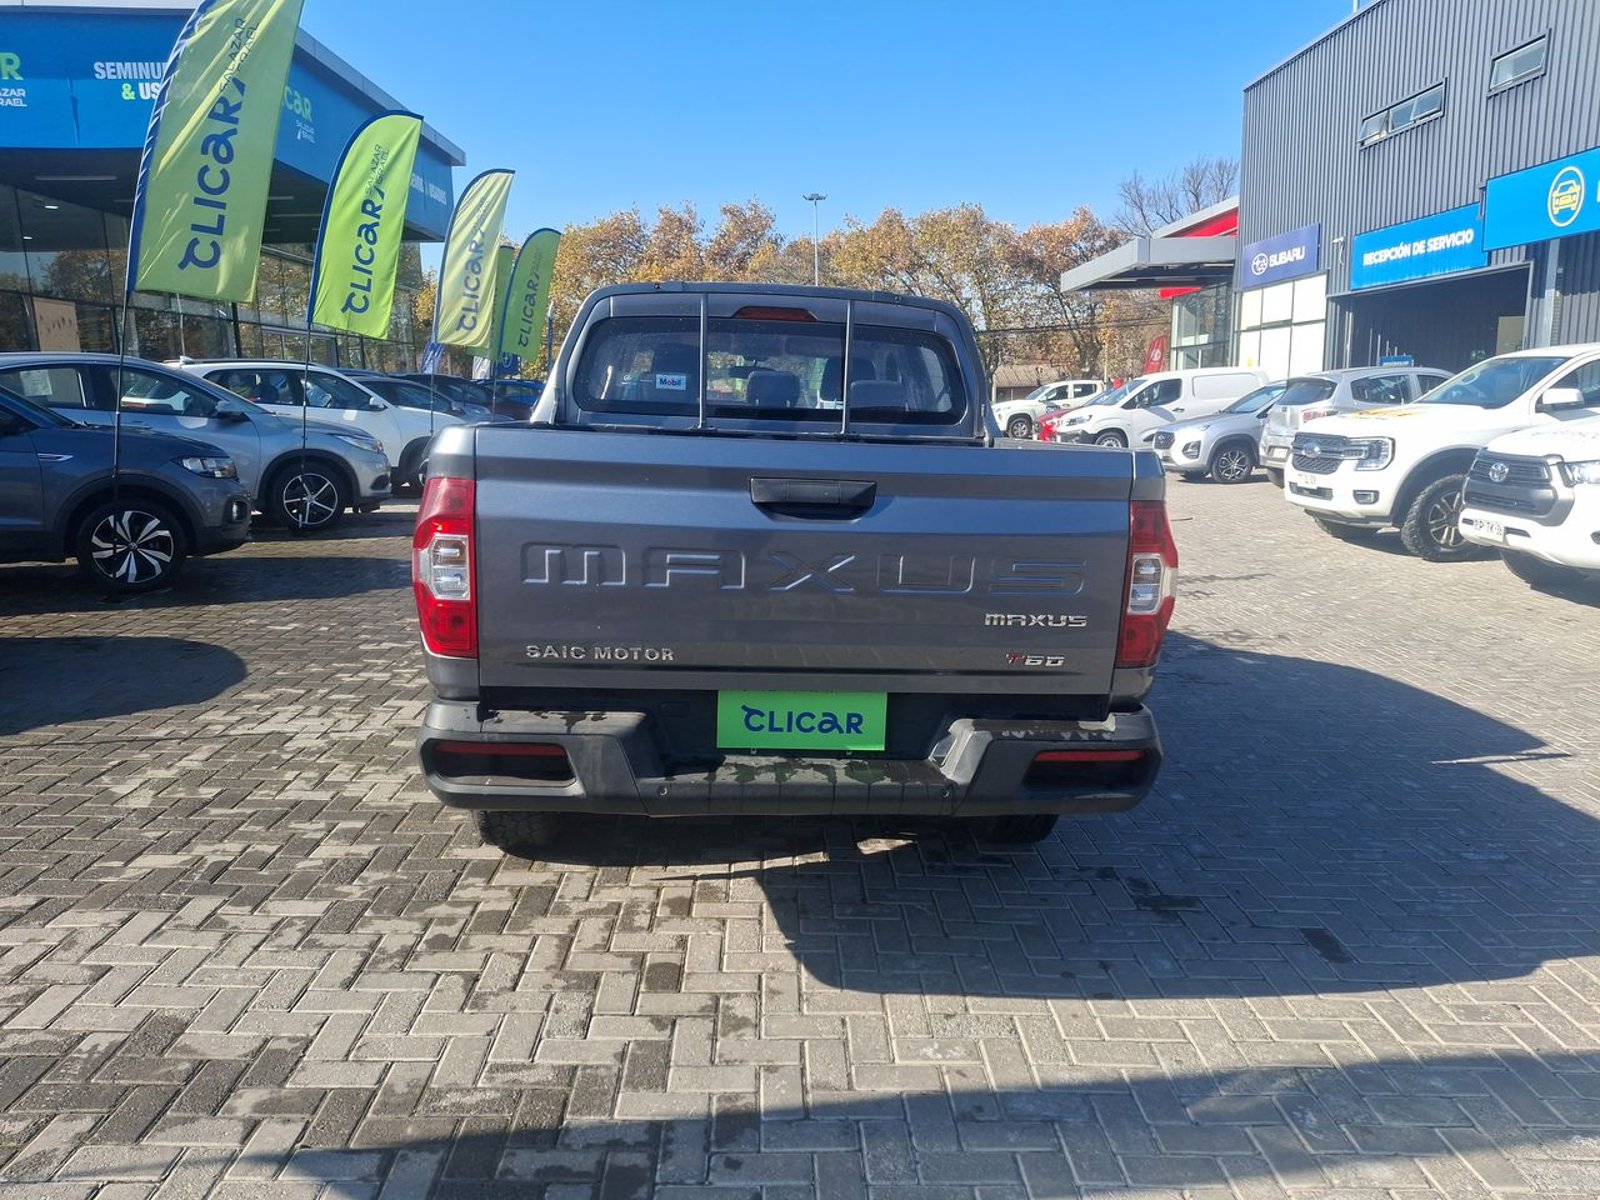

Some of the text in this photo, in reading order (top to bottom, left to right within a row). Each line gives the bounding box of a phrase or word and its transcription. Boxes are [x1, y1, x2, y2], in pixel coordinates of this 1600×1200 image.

[122, 83, 136, 100] &
[1363, 228, 1475, 267] RECEPCIÓN DE SERVICIO
[1269, 245, 1306, 268] SUBARU
[521, 541, 1087, 595] MAXUS
[984, 613, 1088, 628] MAXUS
[526, 644, 674, 661] SAIC MOTOR
[1006, 653, 1065, 667] T60
